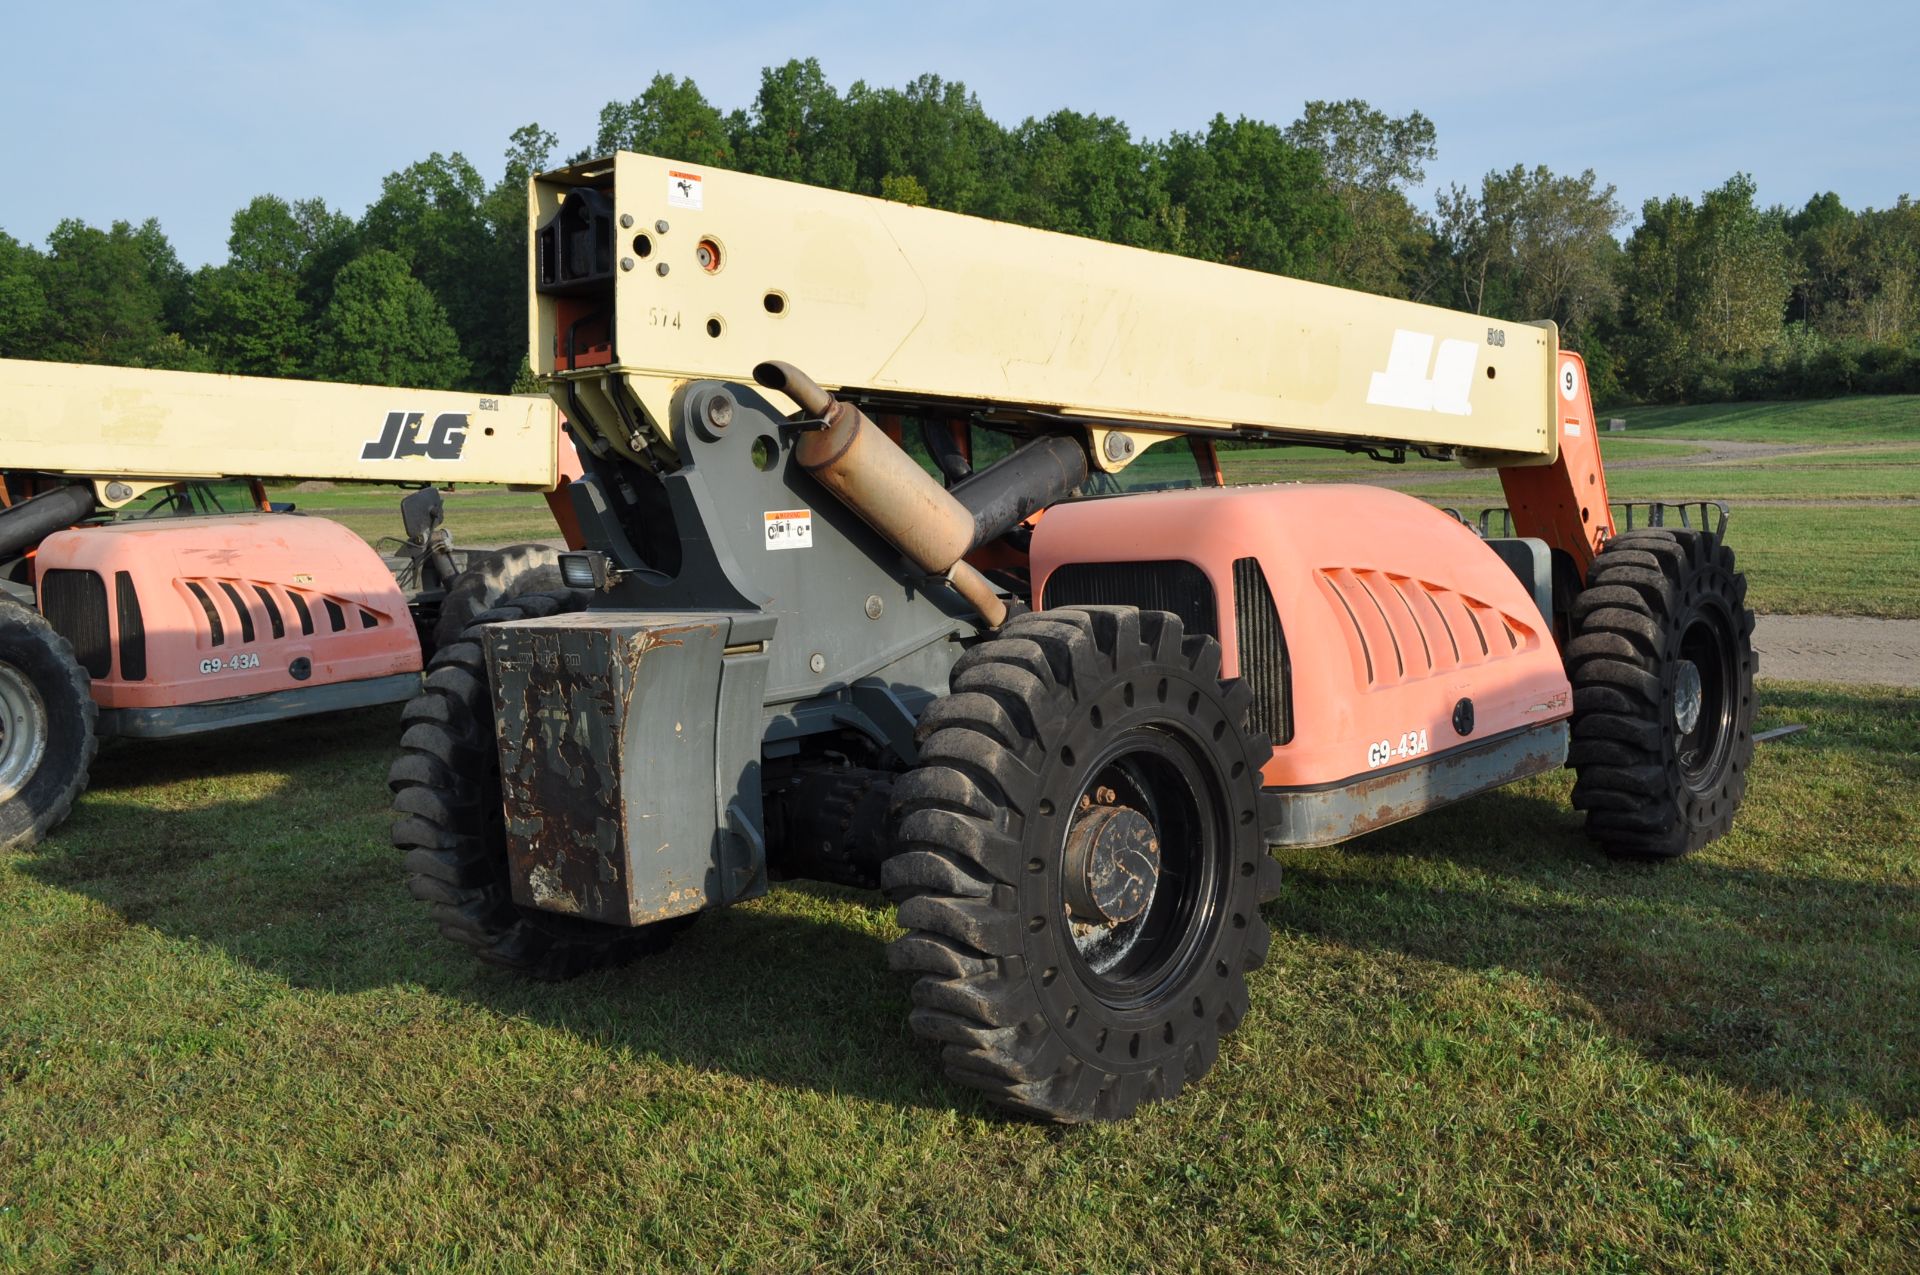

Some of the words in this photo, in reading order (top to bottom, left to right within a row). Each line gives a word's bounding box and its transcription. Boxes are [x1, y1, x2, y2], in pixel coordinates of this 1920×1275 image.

[1565, 371, 1573, 391] 9
[479, 398, 499, 411] 521
[361, 411, 472, 461] JLG
[200, 653, 260, 674] G9-43A
[1368, 728, 1429, 768] G9-43A
